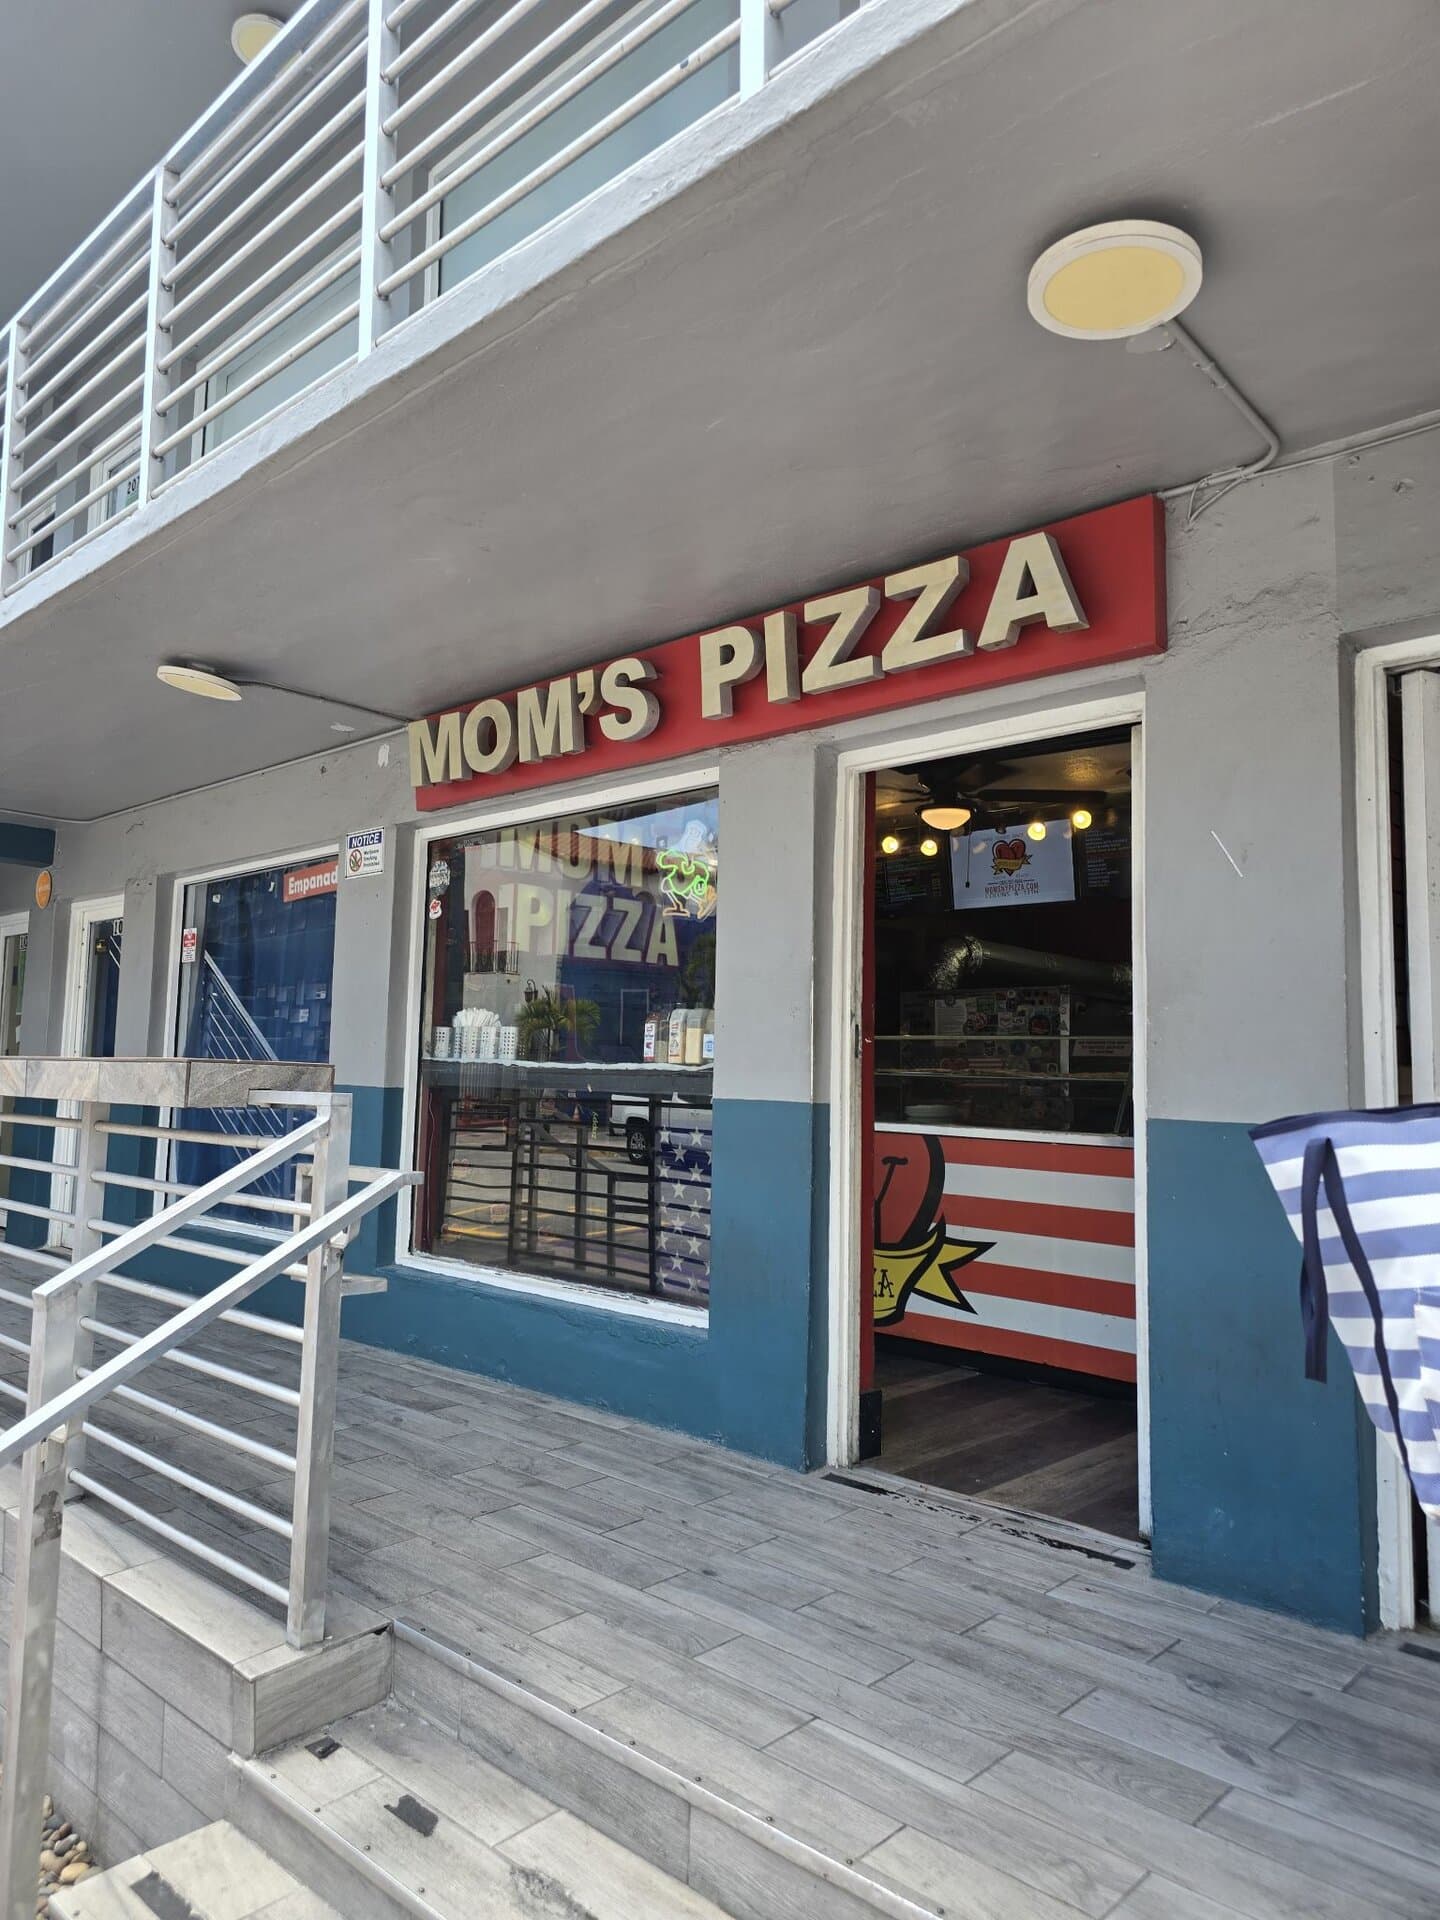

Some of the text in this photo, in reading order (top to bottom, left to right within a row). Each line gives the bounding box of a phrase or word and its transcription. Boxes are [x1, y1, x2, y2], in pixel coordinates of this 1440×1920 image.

[409, 531, 1090, 788] MOM'S PIZZA
[352, 833, 379, 848] NOTICE
[288, 865, 339, 895] Empanad
[514, 882, 680, 968] PIZZA
[873, 1268, 895, 1298] A
